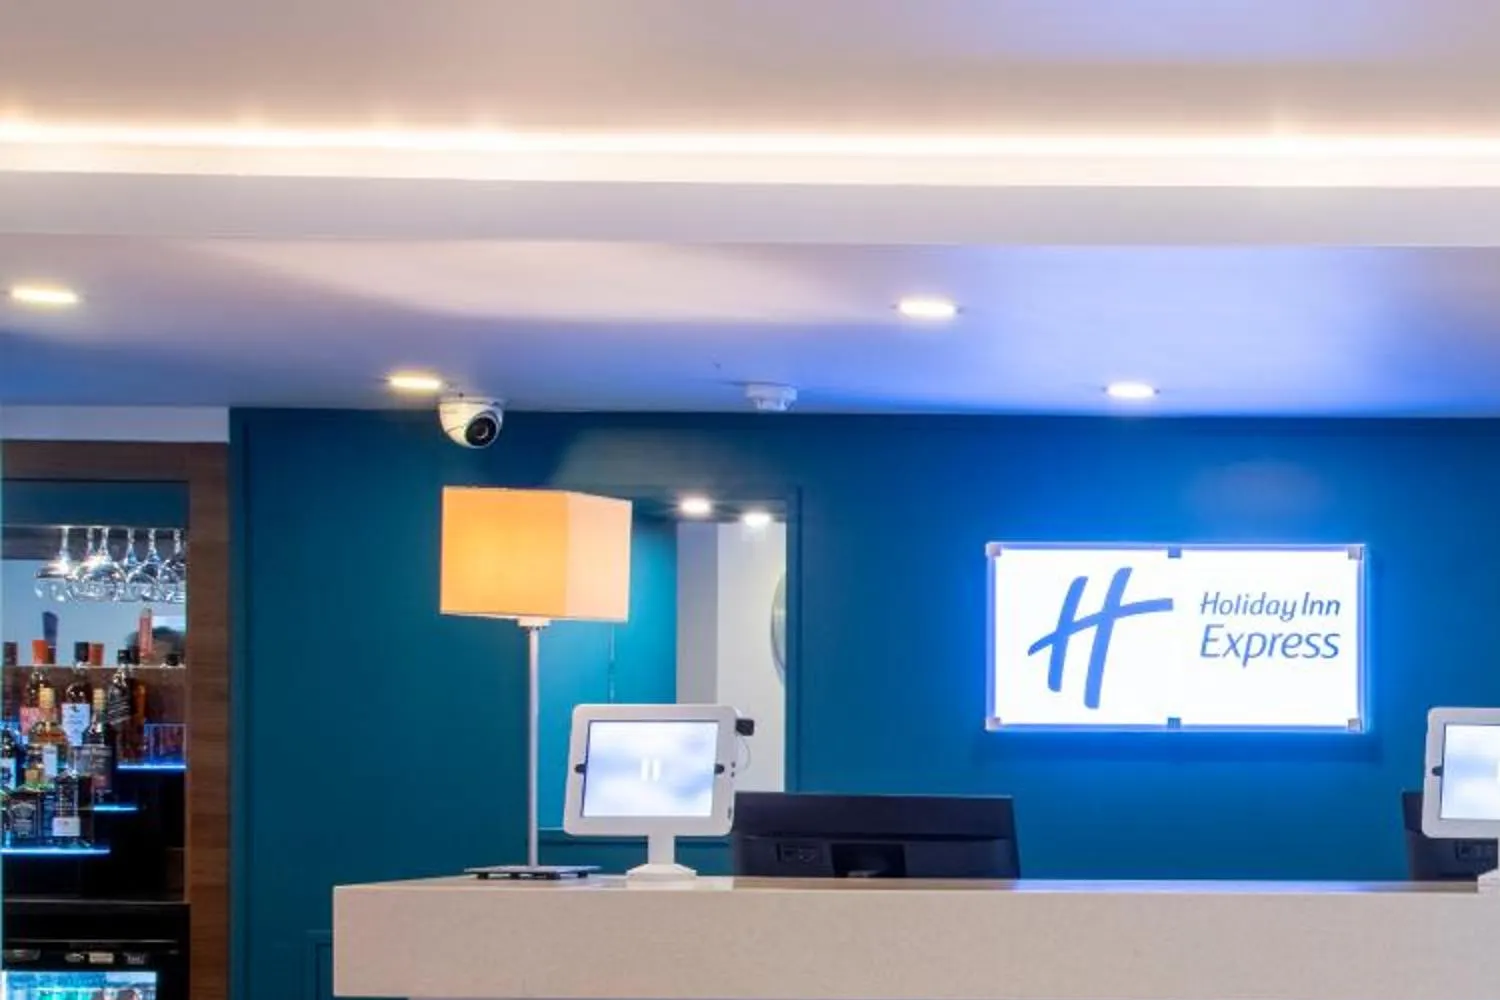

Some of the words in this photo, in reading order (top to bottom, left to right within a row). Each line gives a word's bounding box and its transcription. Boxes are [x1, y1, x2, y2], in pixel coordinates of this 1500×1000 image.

[1200, 590, 1297, 622] Holiday
[1301, 591, 1341, 616] Inn
[1027, 566, 1174, 710] H
[1199, 623, 1340, 667] Express
